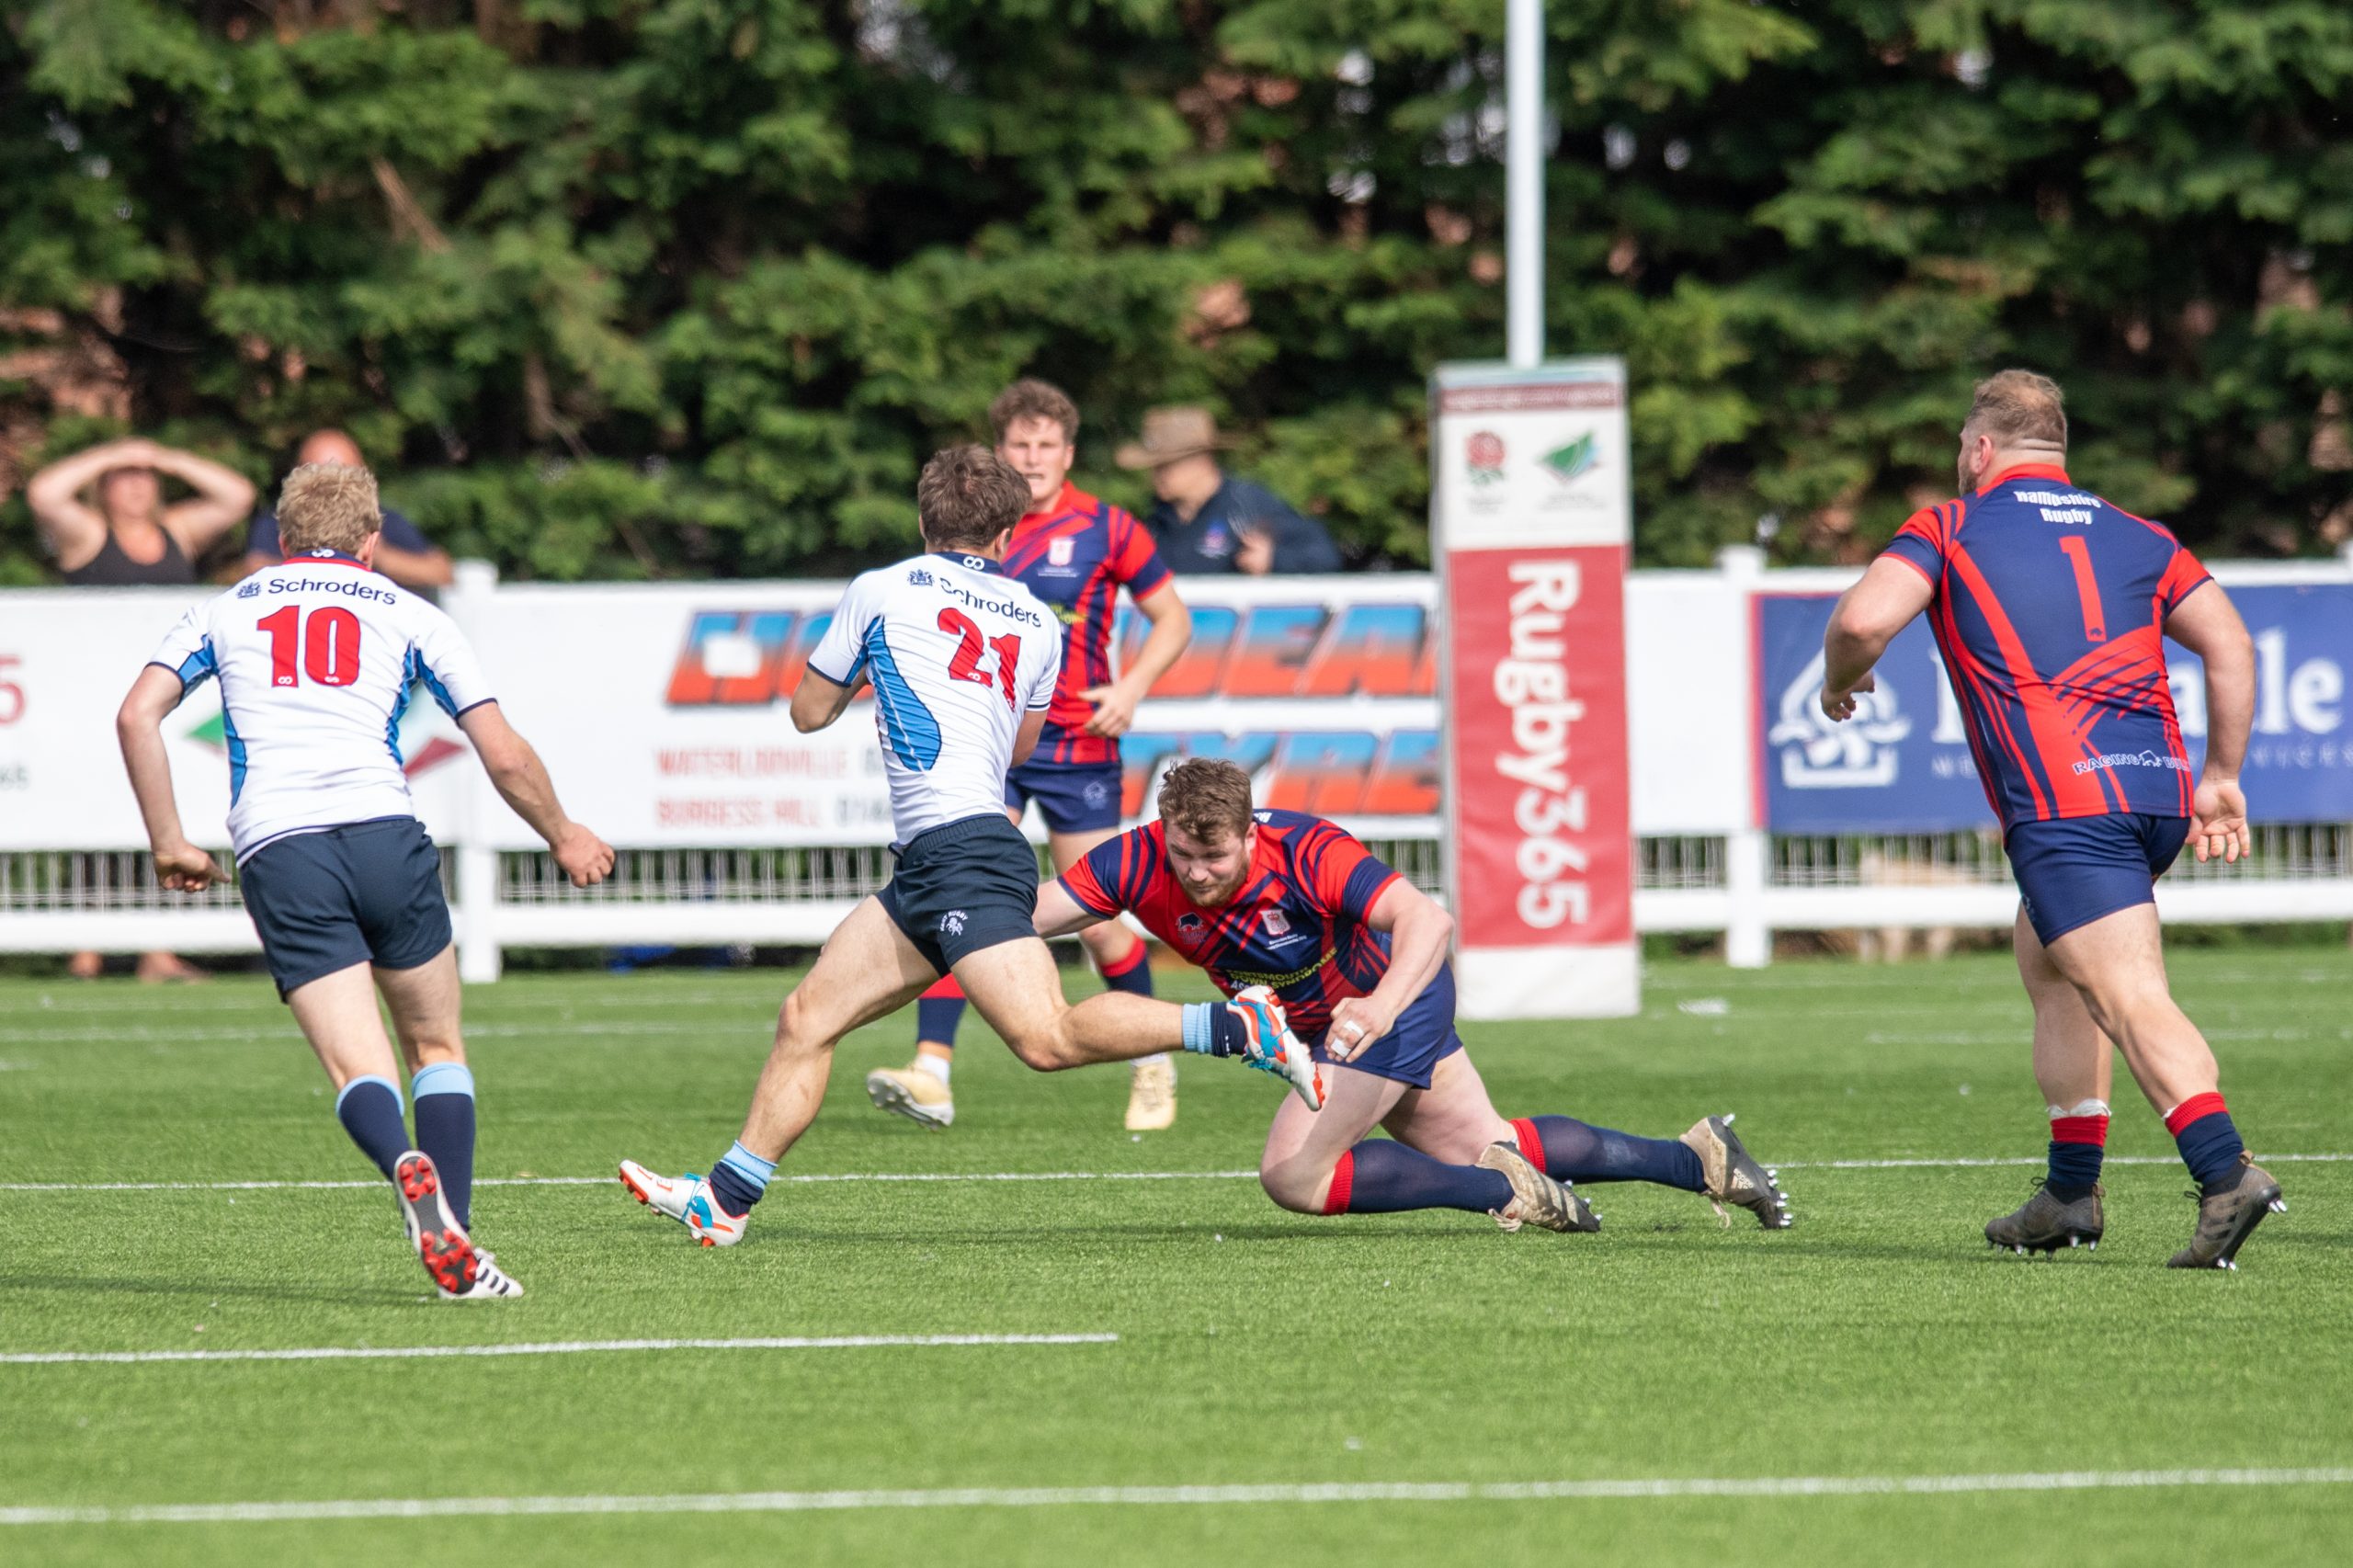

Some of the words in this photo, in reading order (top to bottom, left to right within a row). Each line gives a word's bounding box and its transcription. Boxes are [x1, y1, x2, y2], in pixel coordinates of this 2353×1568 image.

[2040, 507, 2093, 525] Rugby
[268, 578, 396, 605] Schroders
[939, 577, 1041, 628] Schroders
[2058, 535, 2108, 642] 1
[256, 605, 361, 688] 10
[938, 608, 1021, 712] 21
[1493, 559, 1589, 929] Rugby365
[2072, 754, 2140, 776] RAGING
